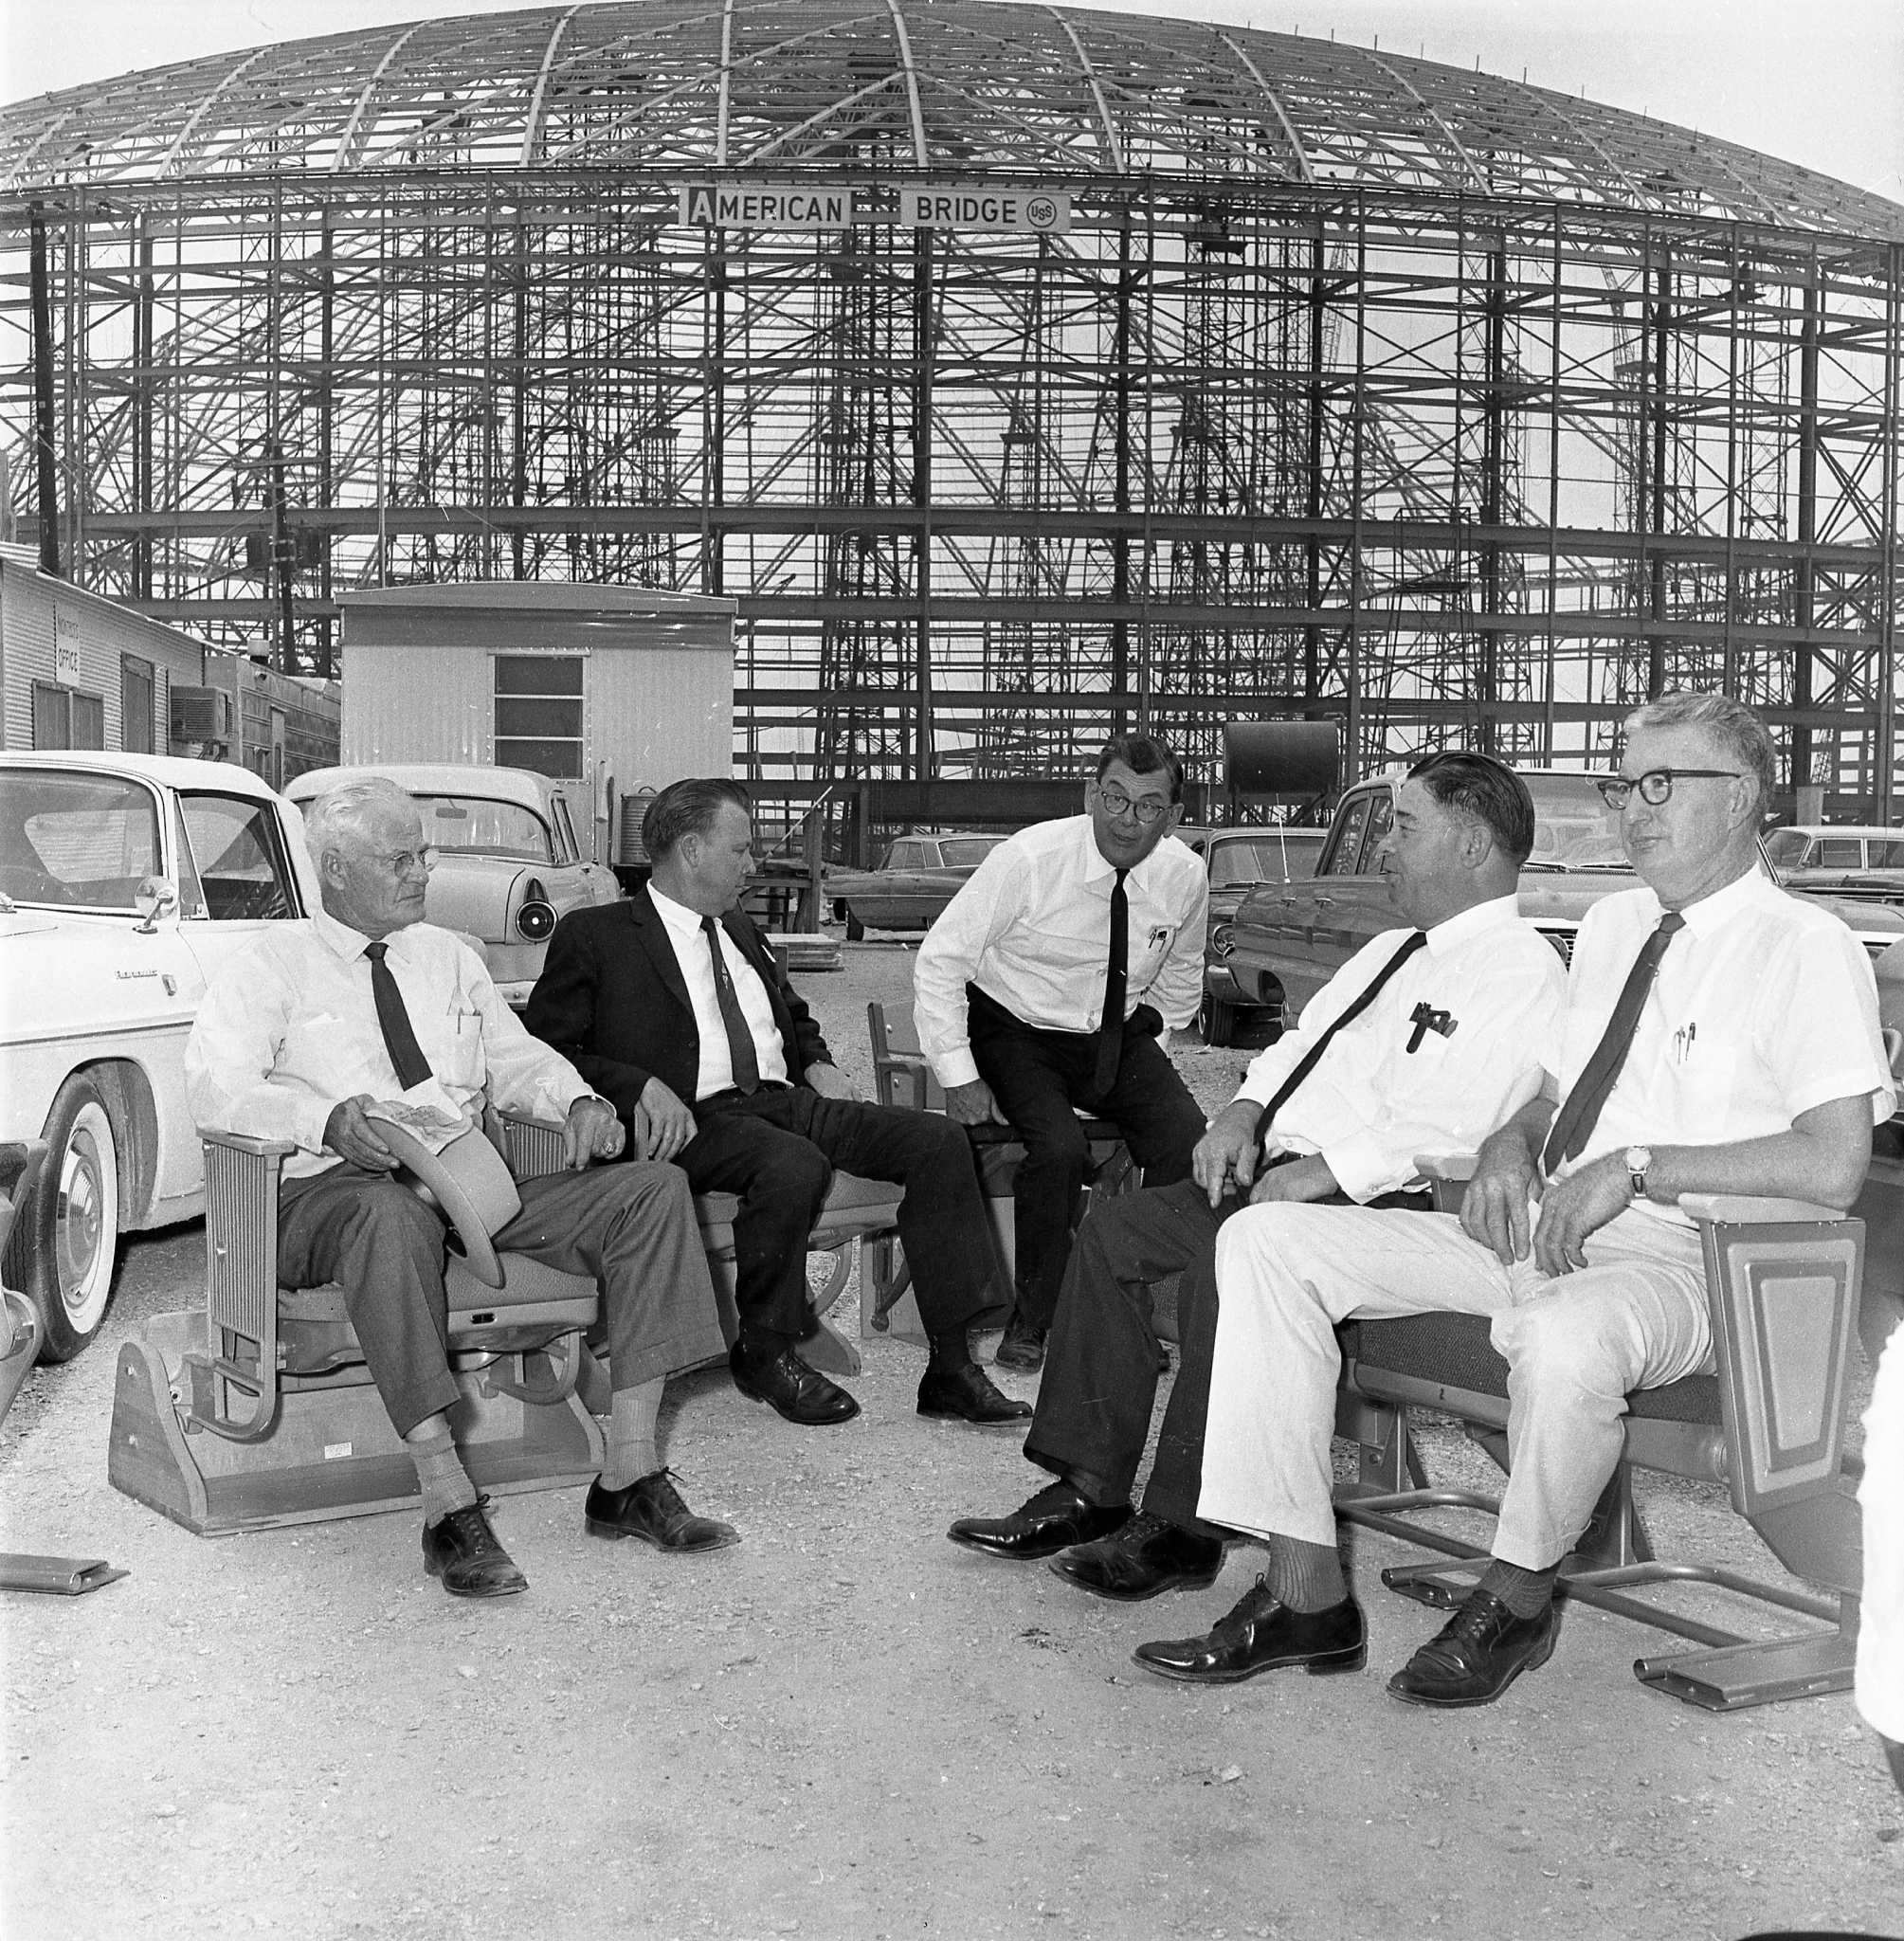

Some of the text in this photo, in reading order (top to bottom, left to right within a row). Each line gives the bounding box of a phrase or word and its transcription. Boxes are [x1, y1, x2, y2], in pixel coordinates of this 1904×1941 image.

[690, 190, 1053, 224] AMERICAN BRIDGE USS
[58, 647, 78, 672] OFFICE
